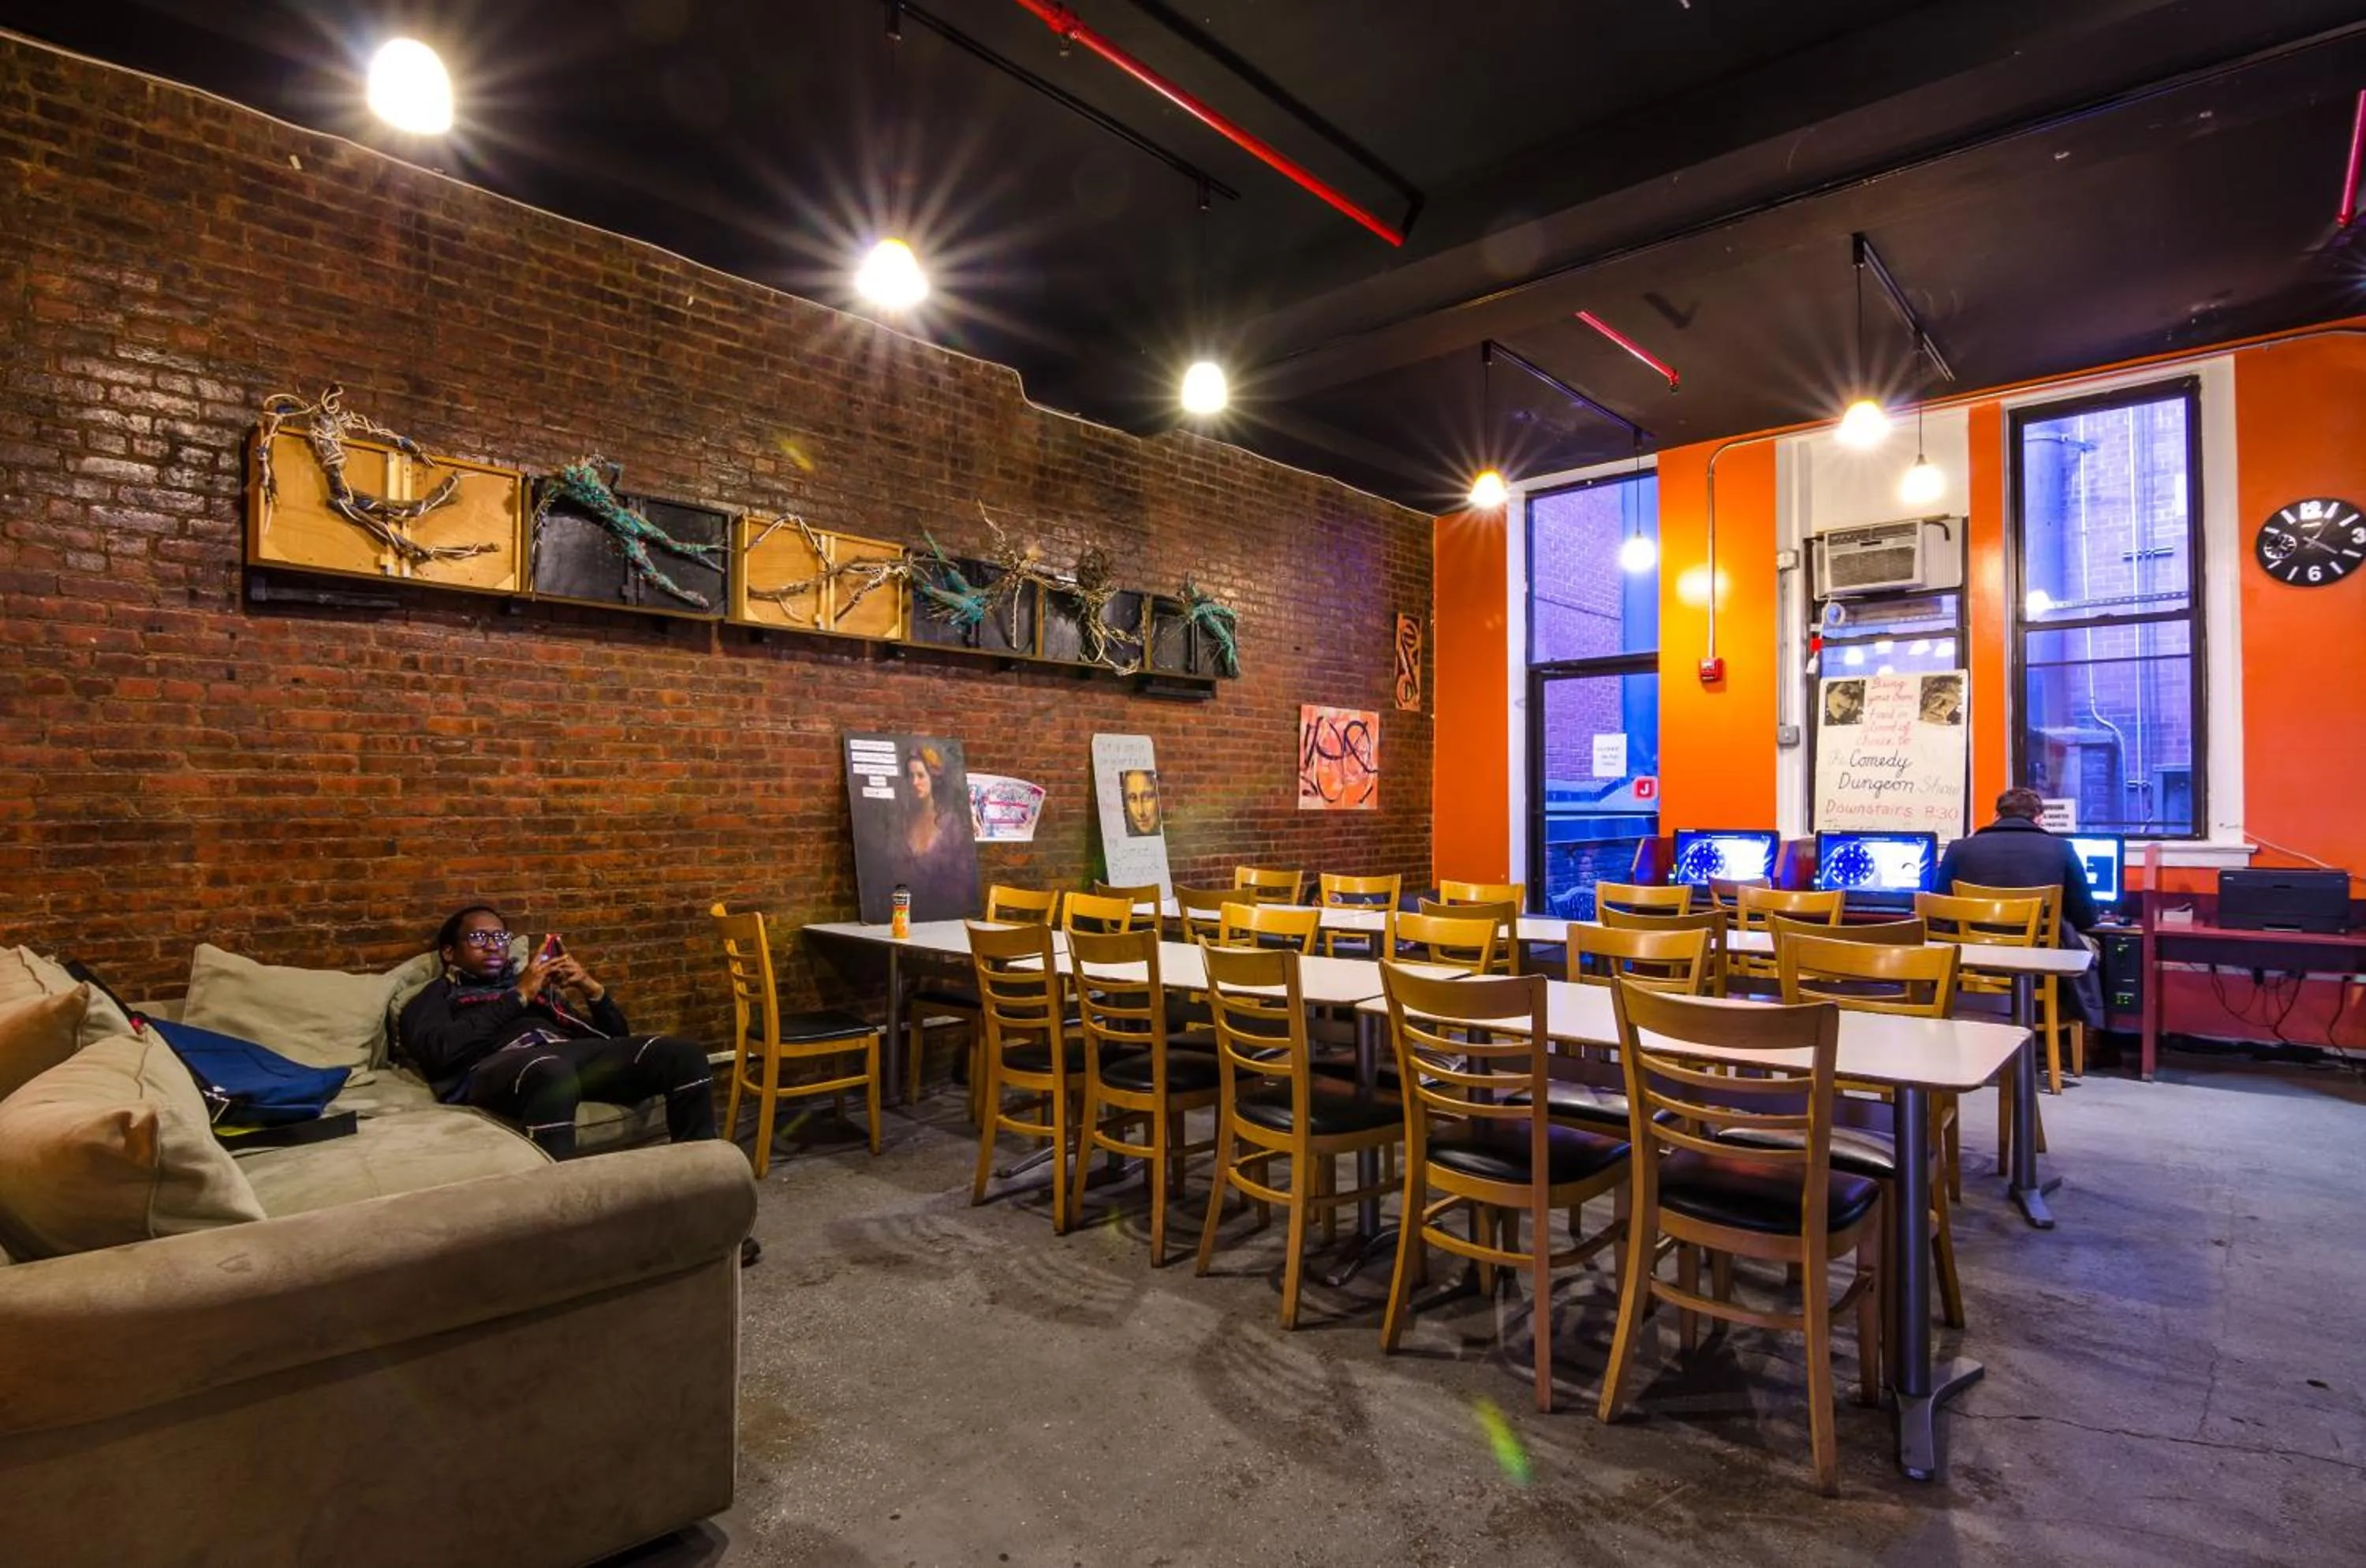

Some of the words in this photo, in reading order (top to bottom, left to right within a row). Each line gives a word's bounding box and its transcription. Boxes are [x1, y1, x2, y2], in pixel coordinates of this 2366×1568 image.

[2351, 527, 2366, 544] 3
[2308, 565, 2323, 581] 6
[1849, 749, 1913, 778] Comedy
[1838, 772, 1914, 798] Dungeon
[1825, 799, 1913, 818] Downstairs
